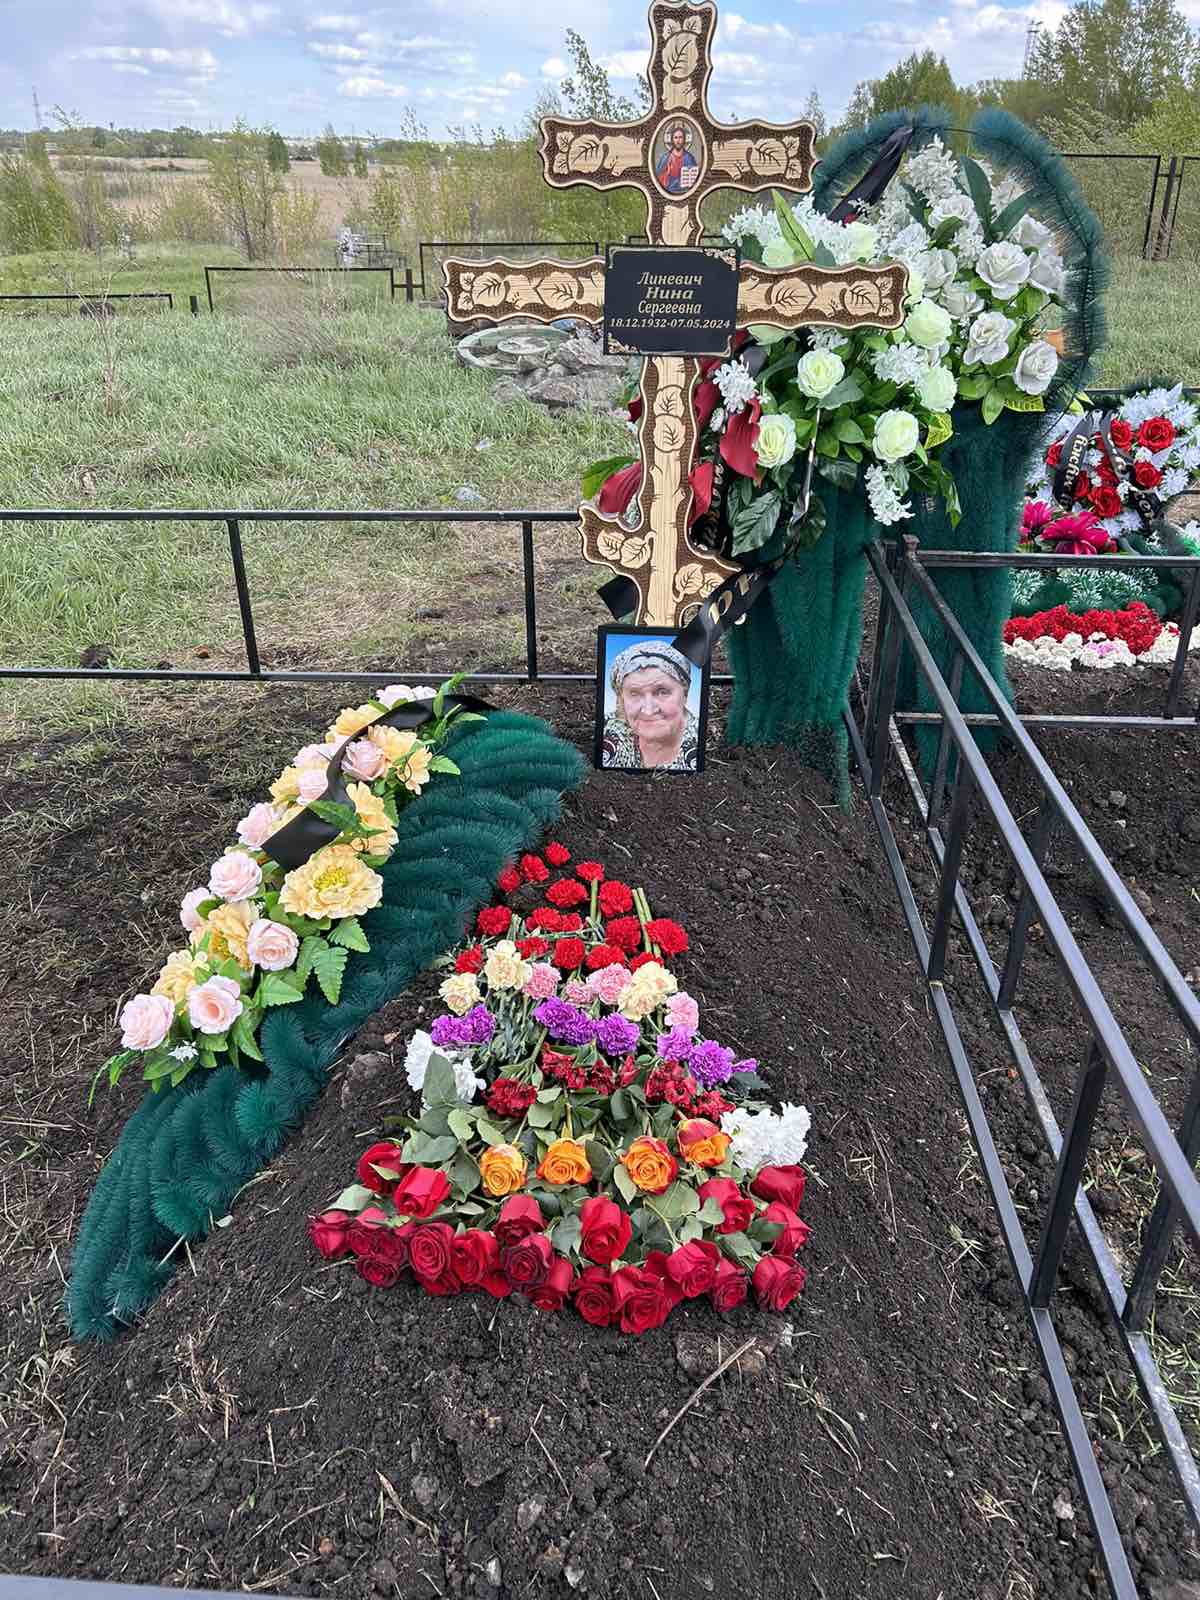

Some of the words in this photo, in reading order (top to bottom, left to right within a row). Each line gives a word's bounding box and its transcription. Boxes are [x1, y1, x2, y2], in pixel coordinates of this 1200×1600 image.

[637, 272, 703, 285] Линевич
[646, 287, 694, 300] Нина
[638, 300, 702, 317] Сергеевна
[610, 318, 730, 329] 18.12.1932-07.05.2024
